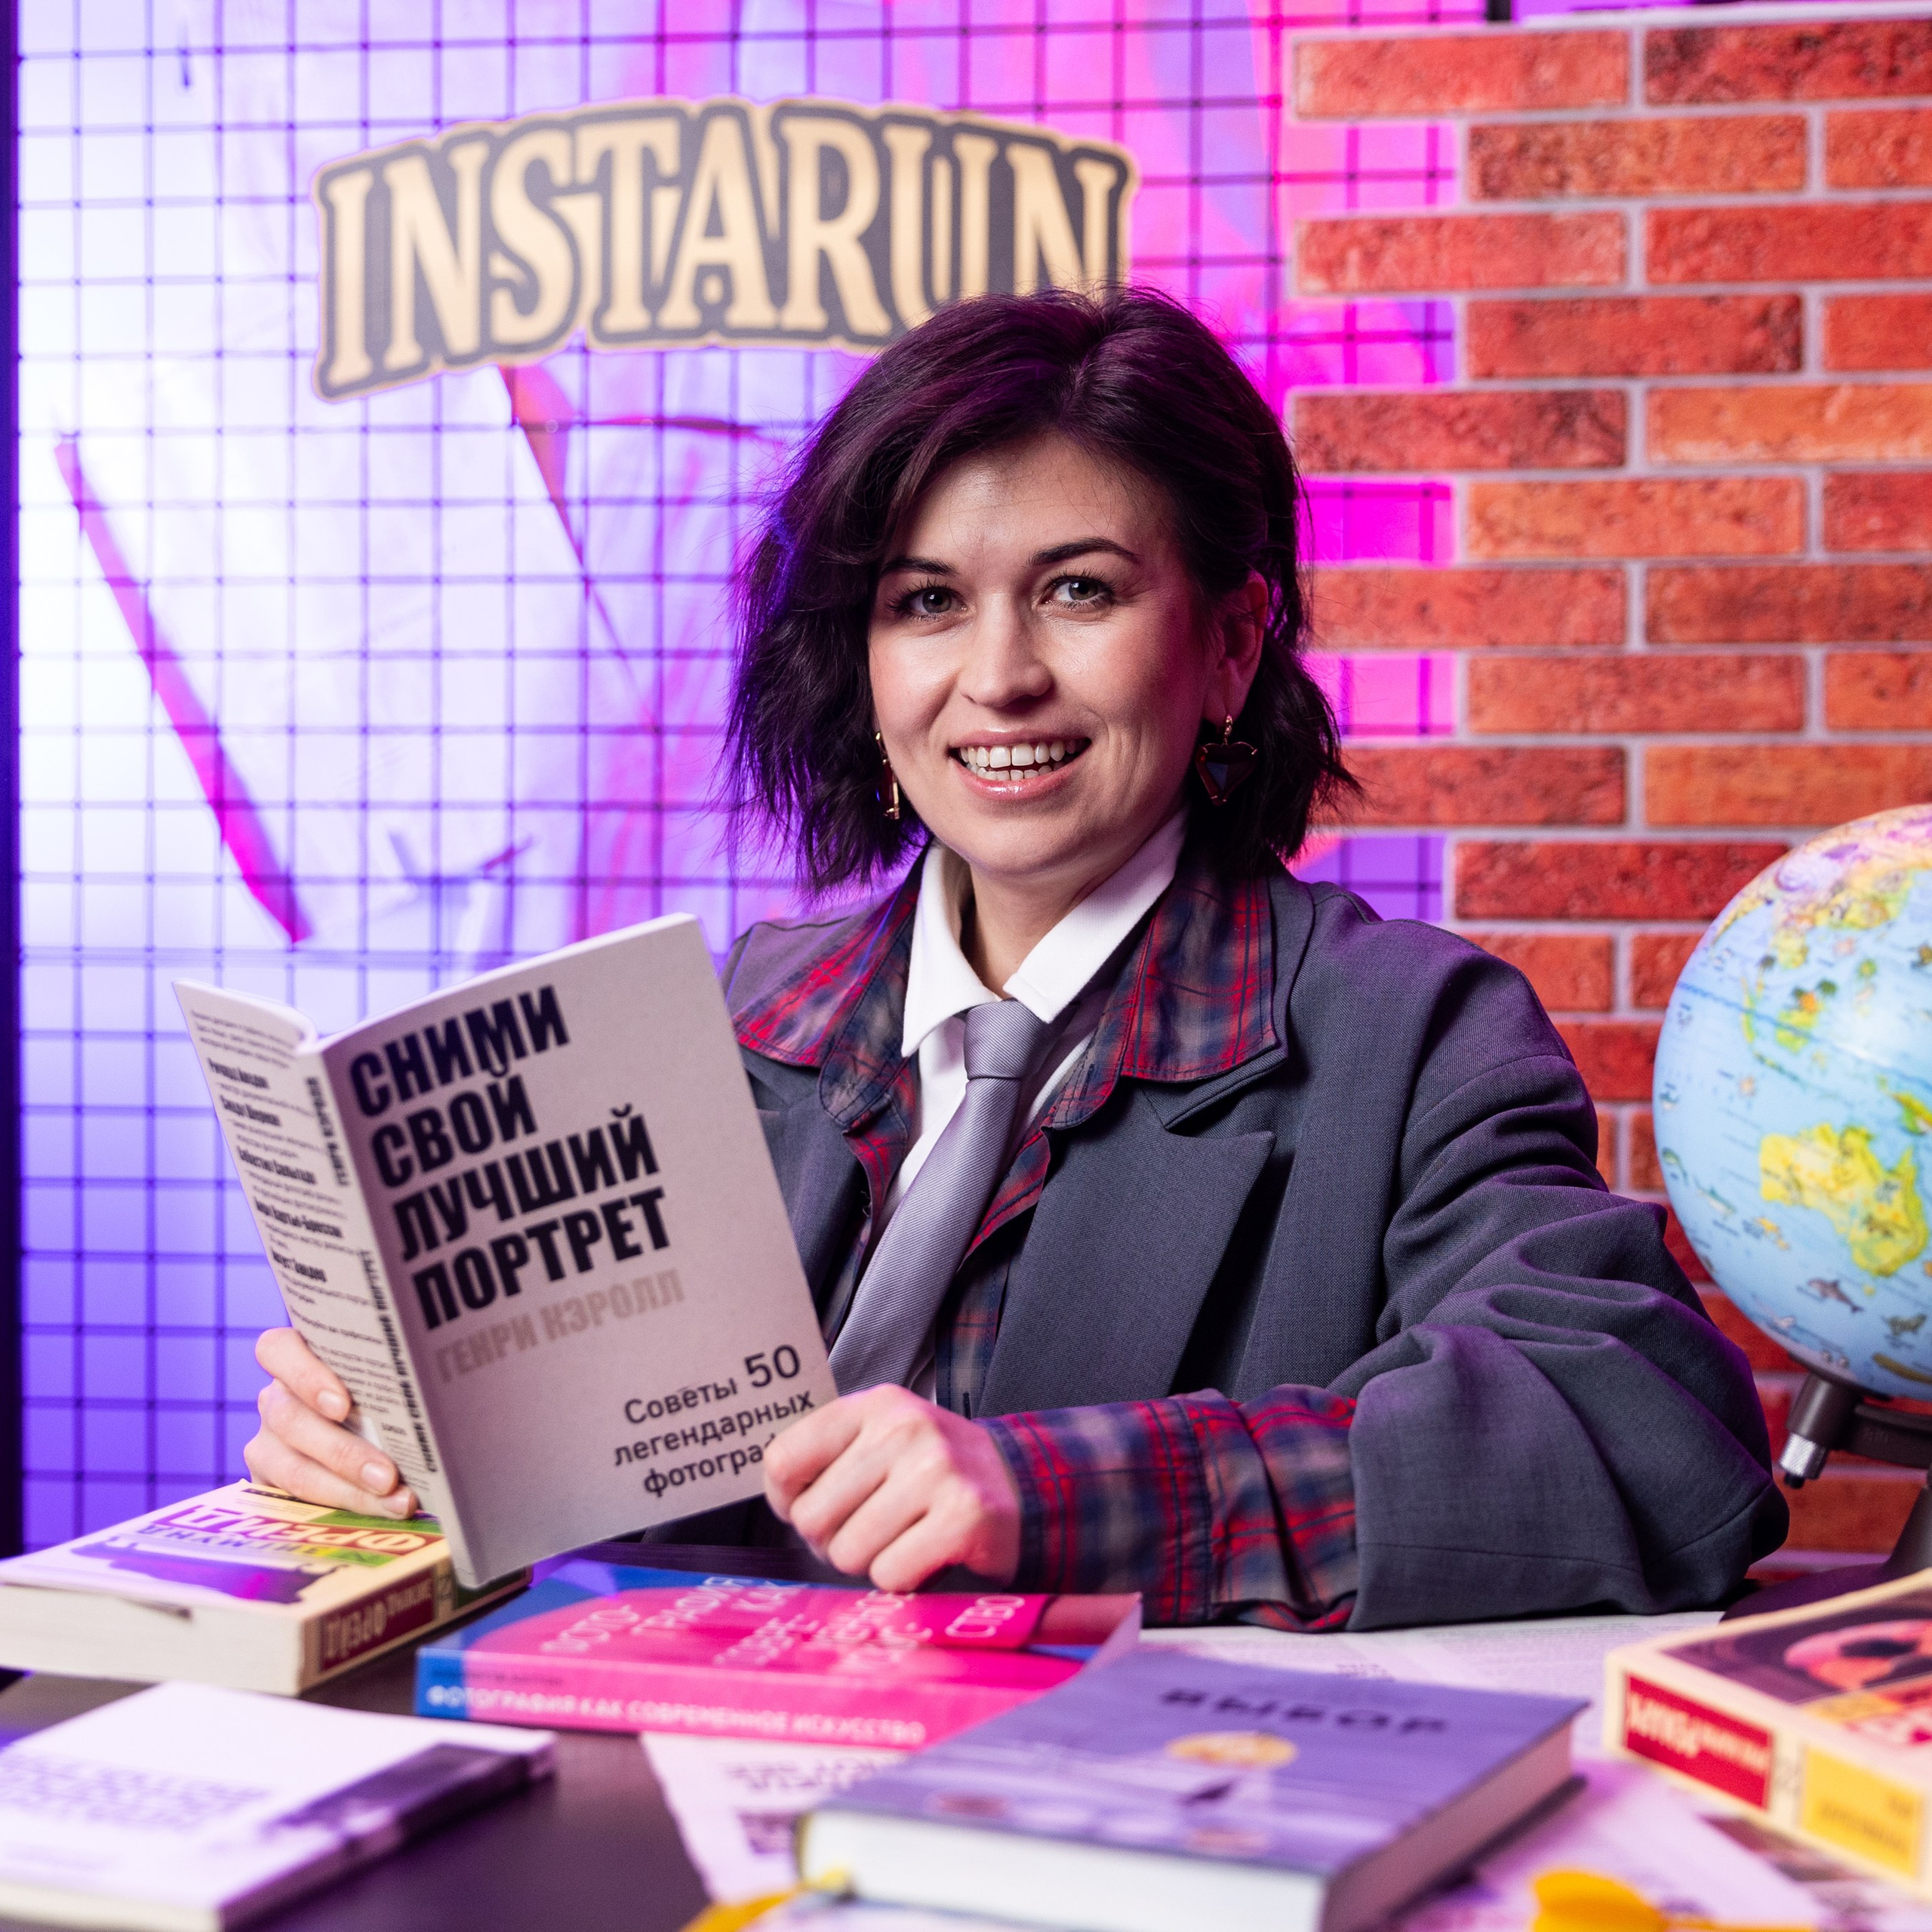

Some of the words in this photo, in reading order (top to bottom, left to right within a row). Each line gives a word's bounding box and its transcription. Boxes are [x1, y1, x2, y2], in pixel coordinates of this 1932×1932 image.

[320, 113, 1124, 389] INSTARUN
[349, 985, 570, 1116] СНИМИ
[371, 1057, 538, 1187] СВОЙ
[392, 1103, 660, 1262] ЛУЧШИЙ
[413, 1186, 670, 1330] ПОРТРЕТ
[434, 1312, 539, 1383] ГЕНРИ
[540, 1269, 685, 1342] КЭРОЛЛ
[614, 1391, 816, 1466] легендарных
[624, 1378, 738, 1423] Советы
[745, 1344, 801, 1387] 50
[644, 1433, 776, 1498] фотогра
[168, 1505, 426, 1550] ФРЕЙД
[426, 1685, 577, 1713] ФОТОГРАФИЯ
